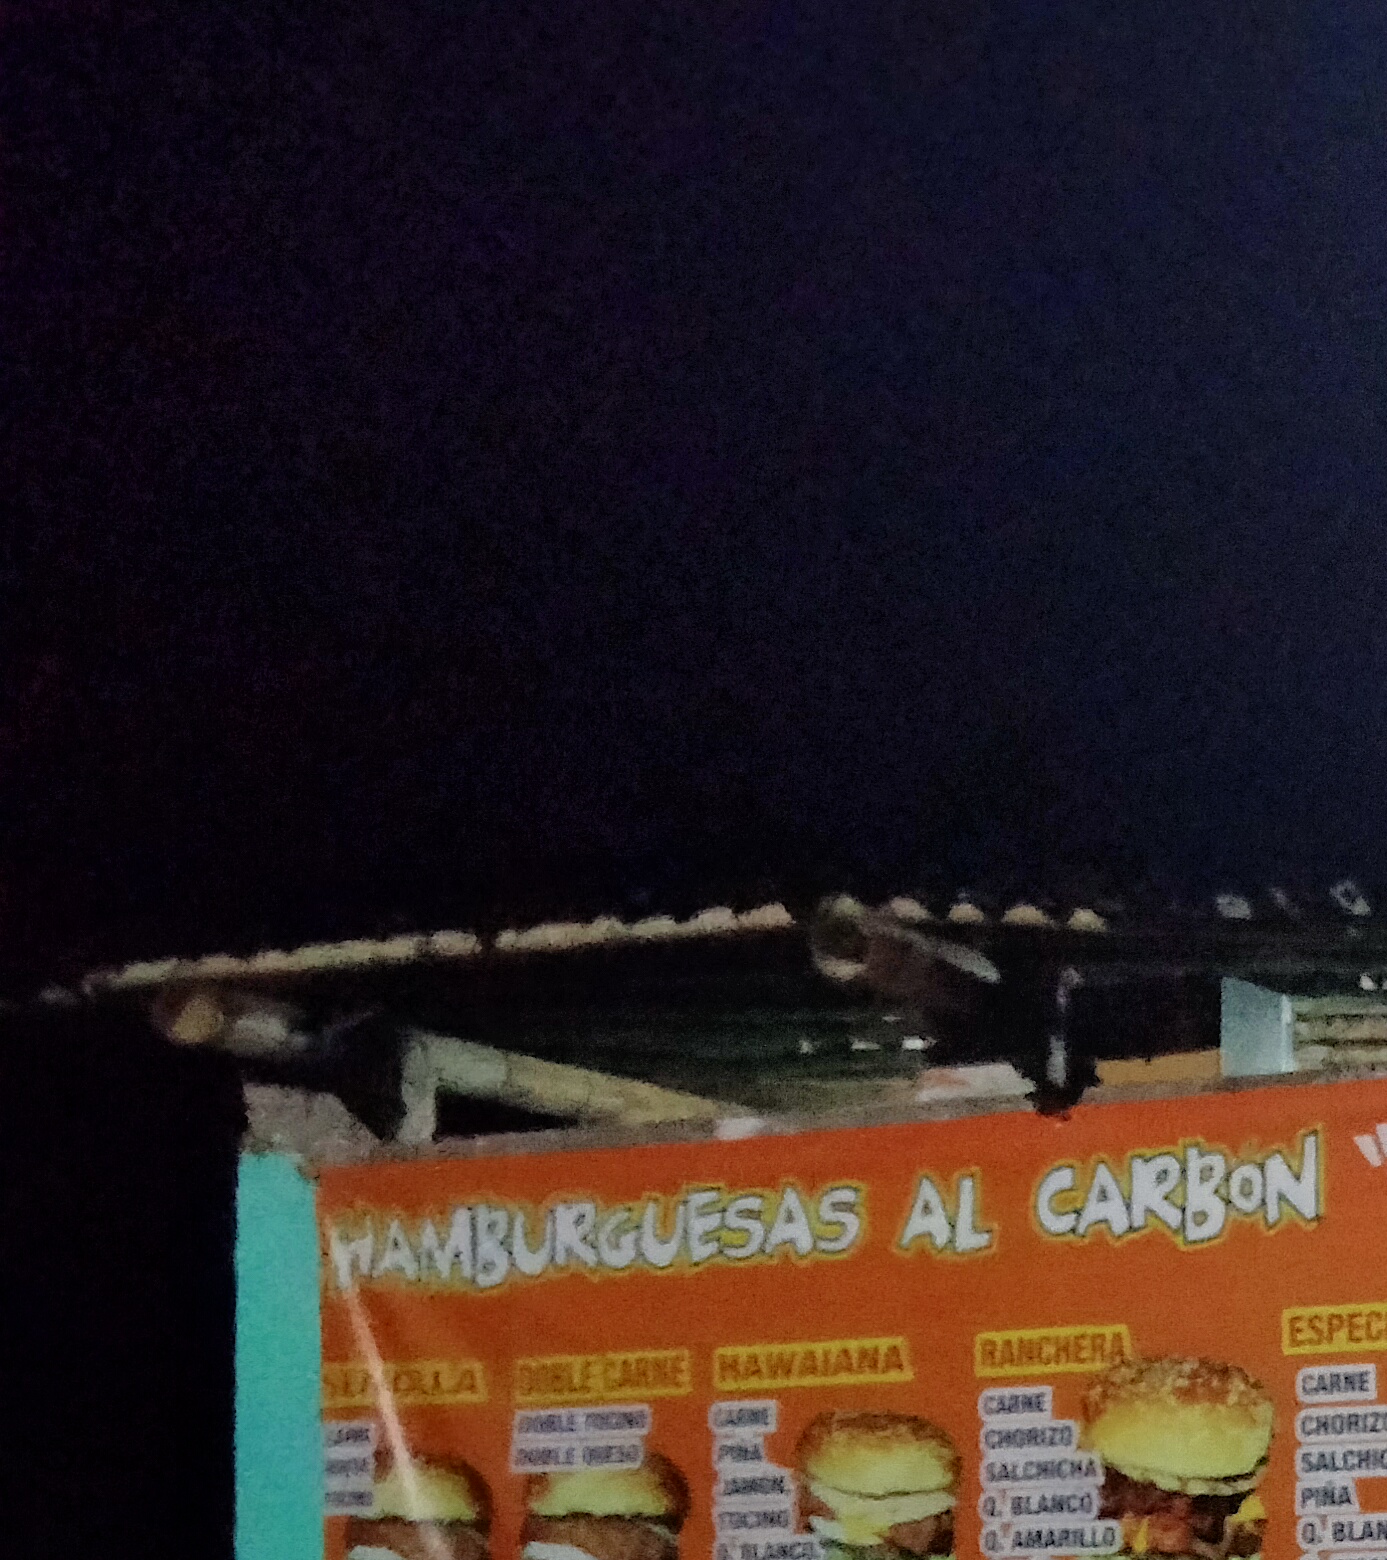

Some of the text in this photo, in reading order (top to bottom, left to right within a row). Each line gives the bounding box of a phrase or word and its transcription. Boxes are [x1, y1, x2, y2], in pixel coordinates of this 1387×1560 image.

[327, 1182, 864, 1290] HAMBURGUESAS
[896, 1172, 996, 1255] AL
[1032, 1129, 1322, 1245] CARBON
[979, 1330, 1128, 1369] RANCHERA
[717, 1343, 905, 1383] HAWAIANA
[1301, 1370, 1372, 1396] CARNE
[982, 1391, 1048, 1416] CARNE
[984, 1424, 1074, 1449] CHORIZO
[985, 1457, 1098, 1483] SALCHICHA
[1010, 1492, 1094, 1517] BLANCO
[1010, 1526, 1117, 1551] AMARILLO
